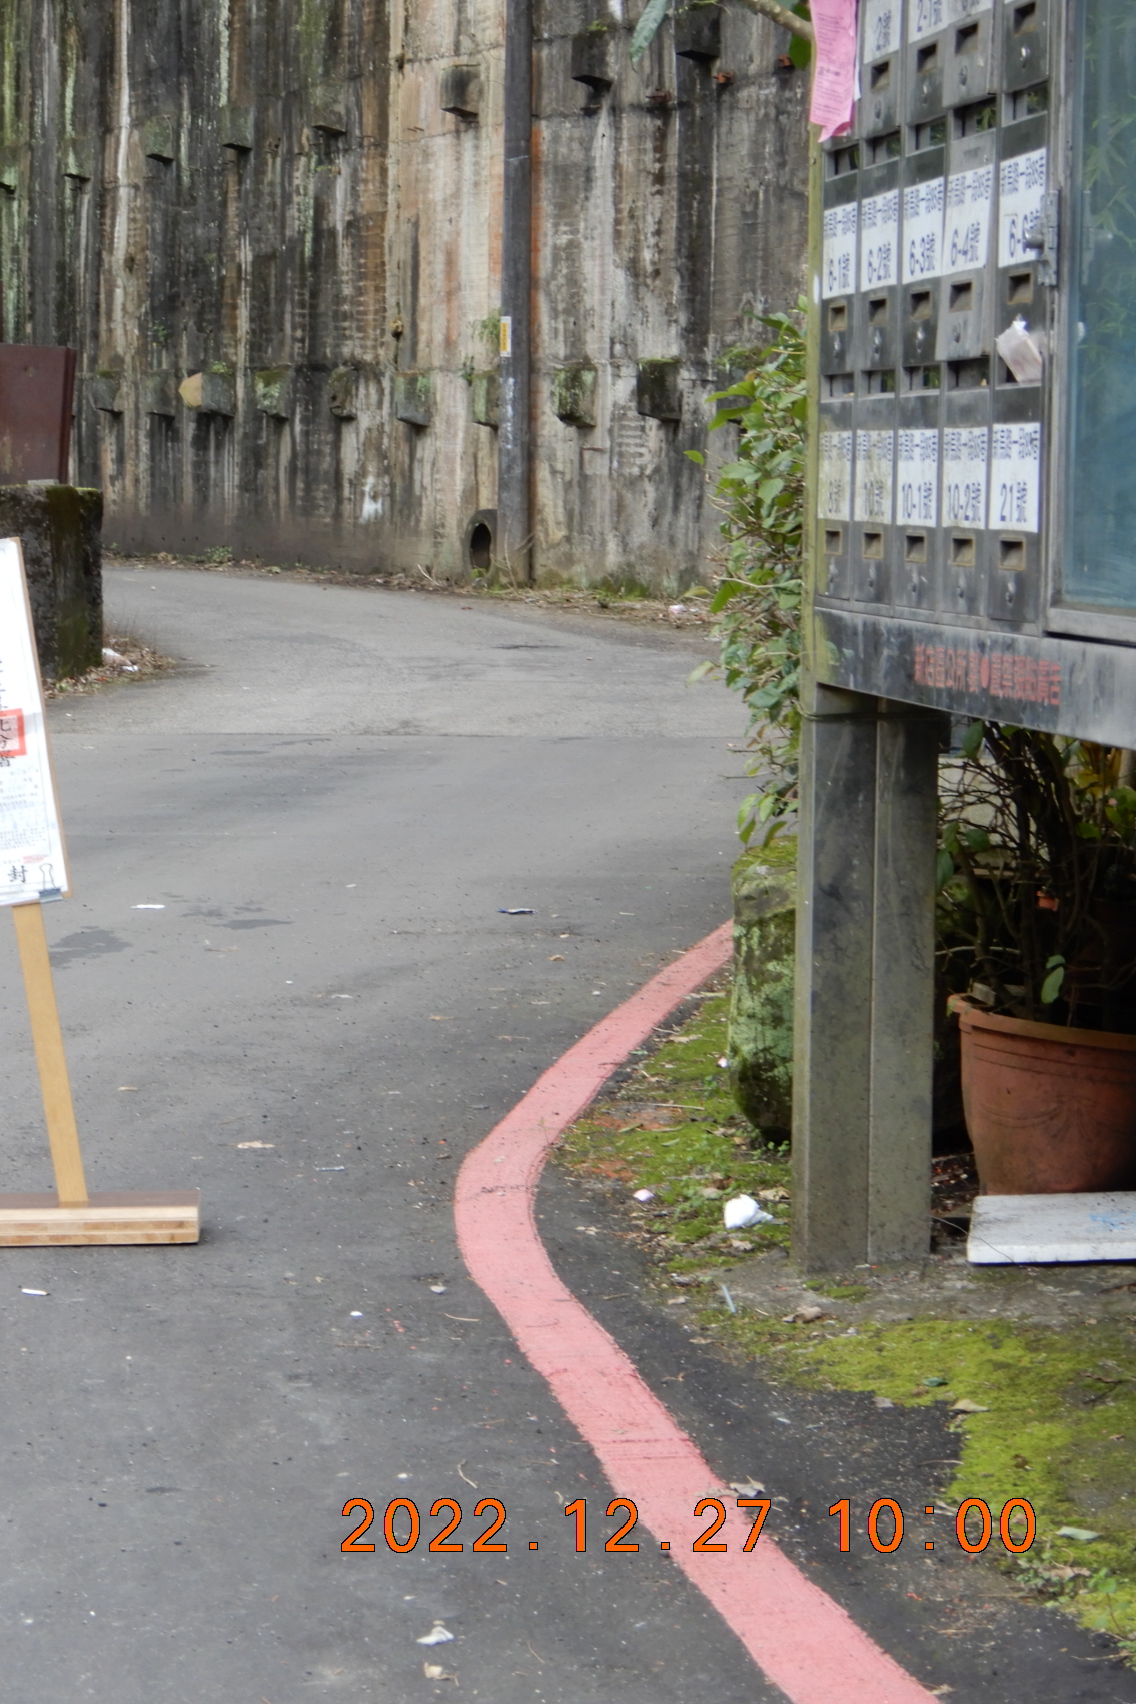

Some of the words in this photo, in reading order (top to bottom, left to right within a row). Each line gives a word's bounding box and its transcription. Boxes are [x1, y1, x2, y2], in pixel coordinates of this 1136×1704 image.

[868, 241, 891, 284] 6-2號
[909, 231, 935, 276] 6-3號
[951, 221, 980, 266] 6-4號
[902, 482, 932, 519] 10-1號
[948, 482, 981, 521] 10-2號
[1000, 482, 1027, 522] 21號
[8, 865, 28, 883] 封
